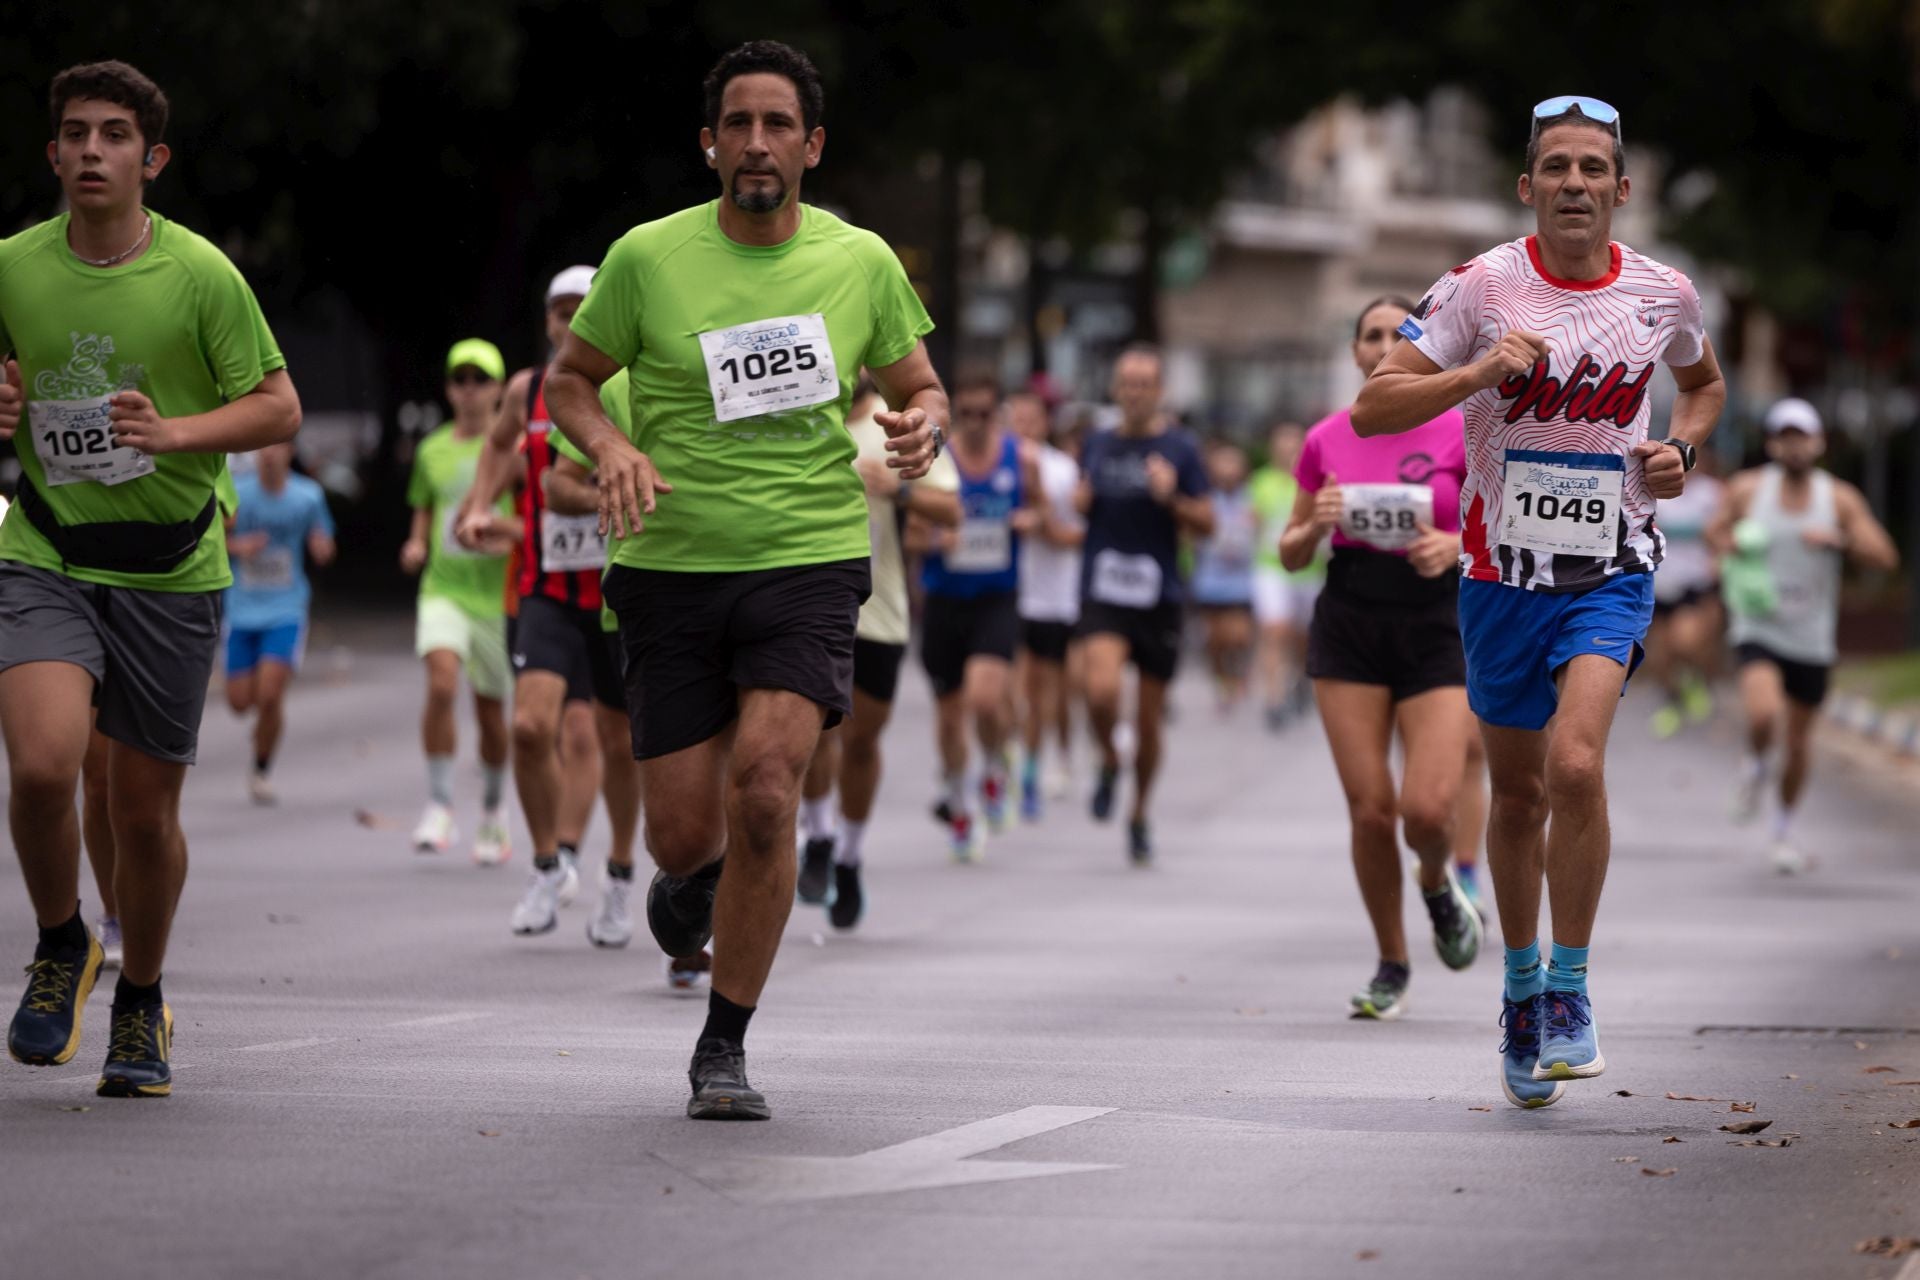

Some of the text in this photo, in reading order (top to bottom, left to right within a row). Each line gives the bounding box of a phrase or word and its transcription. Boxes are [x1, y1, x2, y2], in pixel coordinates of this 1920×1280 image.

[720, 344, 817, 384] 1025
[1498, 354, 1655, 428] Wild
[1351, 509, 1416, 531] 538
[1515, 492, 1605, 523] 1049
